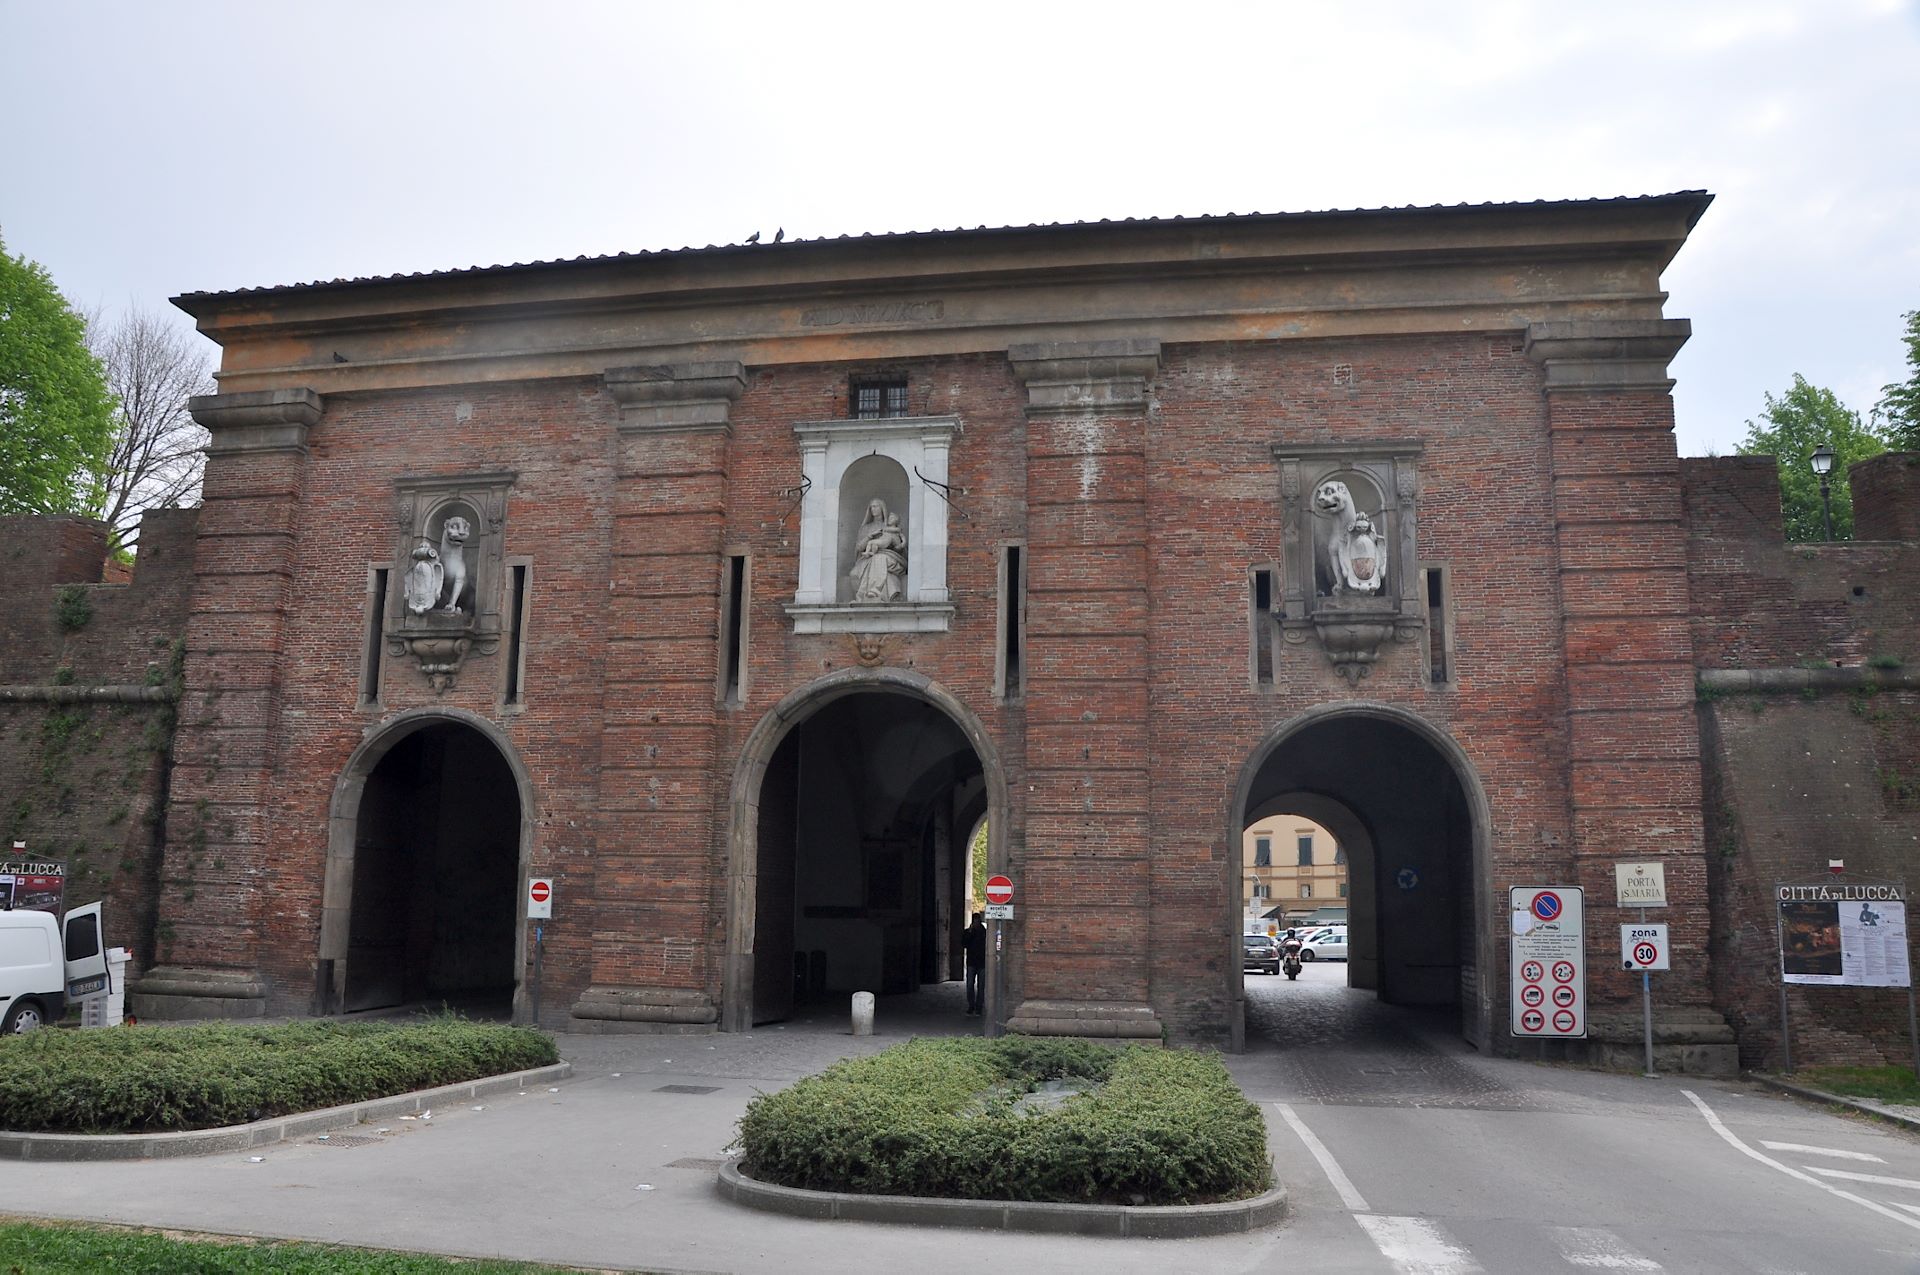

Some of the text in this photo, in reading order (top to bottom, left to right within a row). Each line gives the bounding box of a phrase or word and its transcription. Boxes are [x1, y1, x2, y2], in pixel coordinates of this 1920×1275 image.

[20, 863, 63, 876] LUCCA
[1627, 877, 1656, 887] PORTA
[1832, 892, 1843, 900] DI
[1844, 886, 1900, 900] LUCCA
[1632, 929, 1657, 937] zona
[1638, 948, 1653, 960] 30
